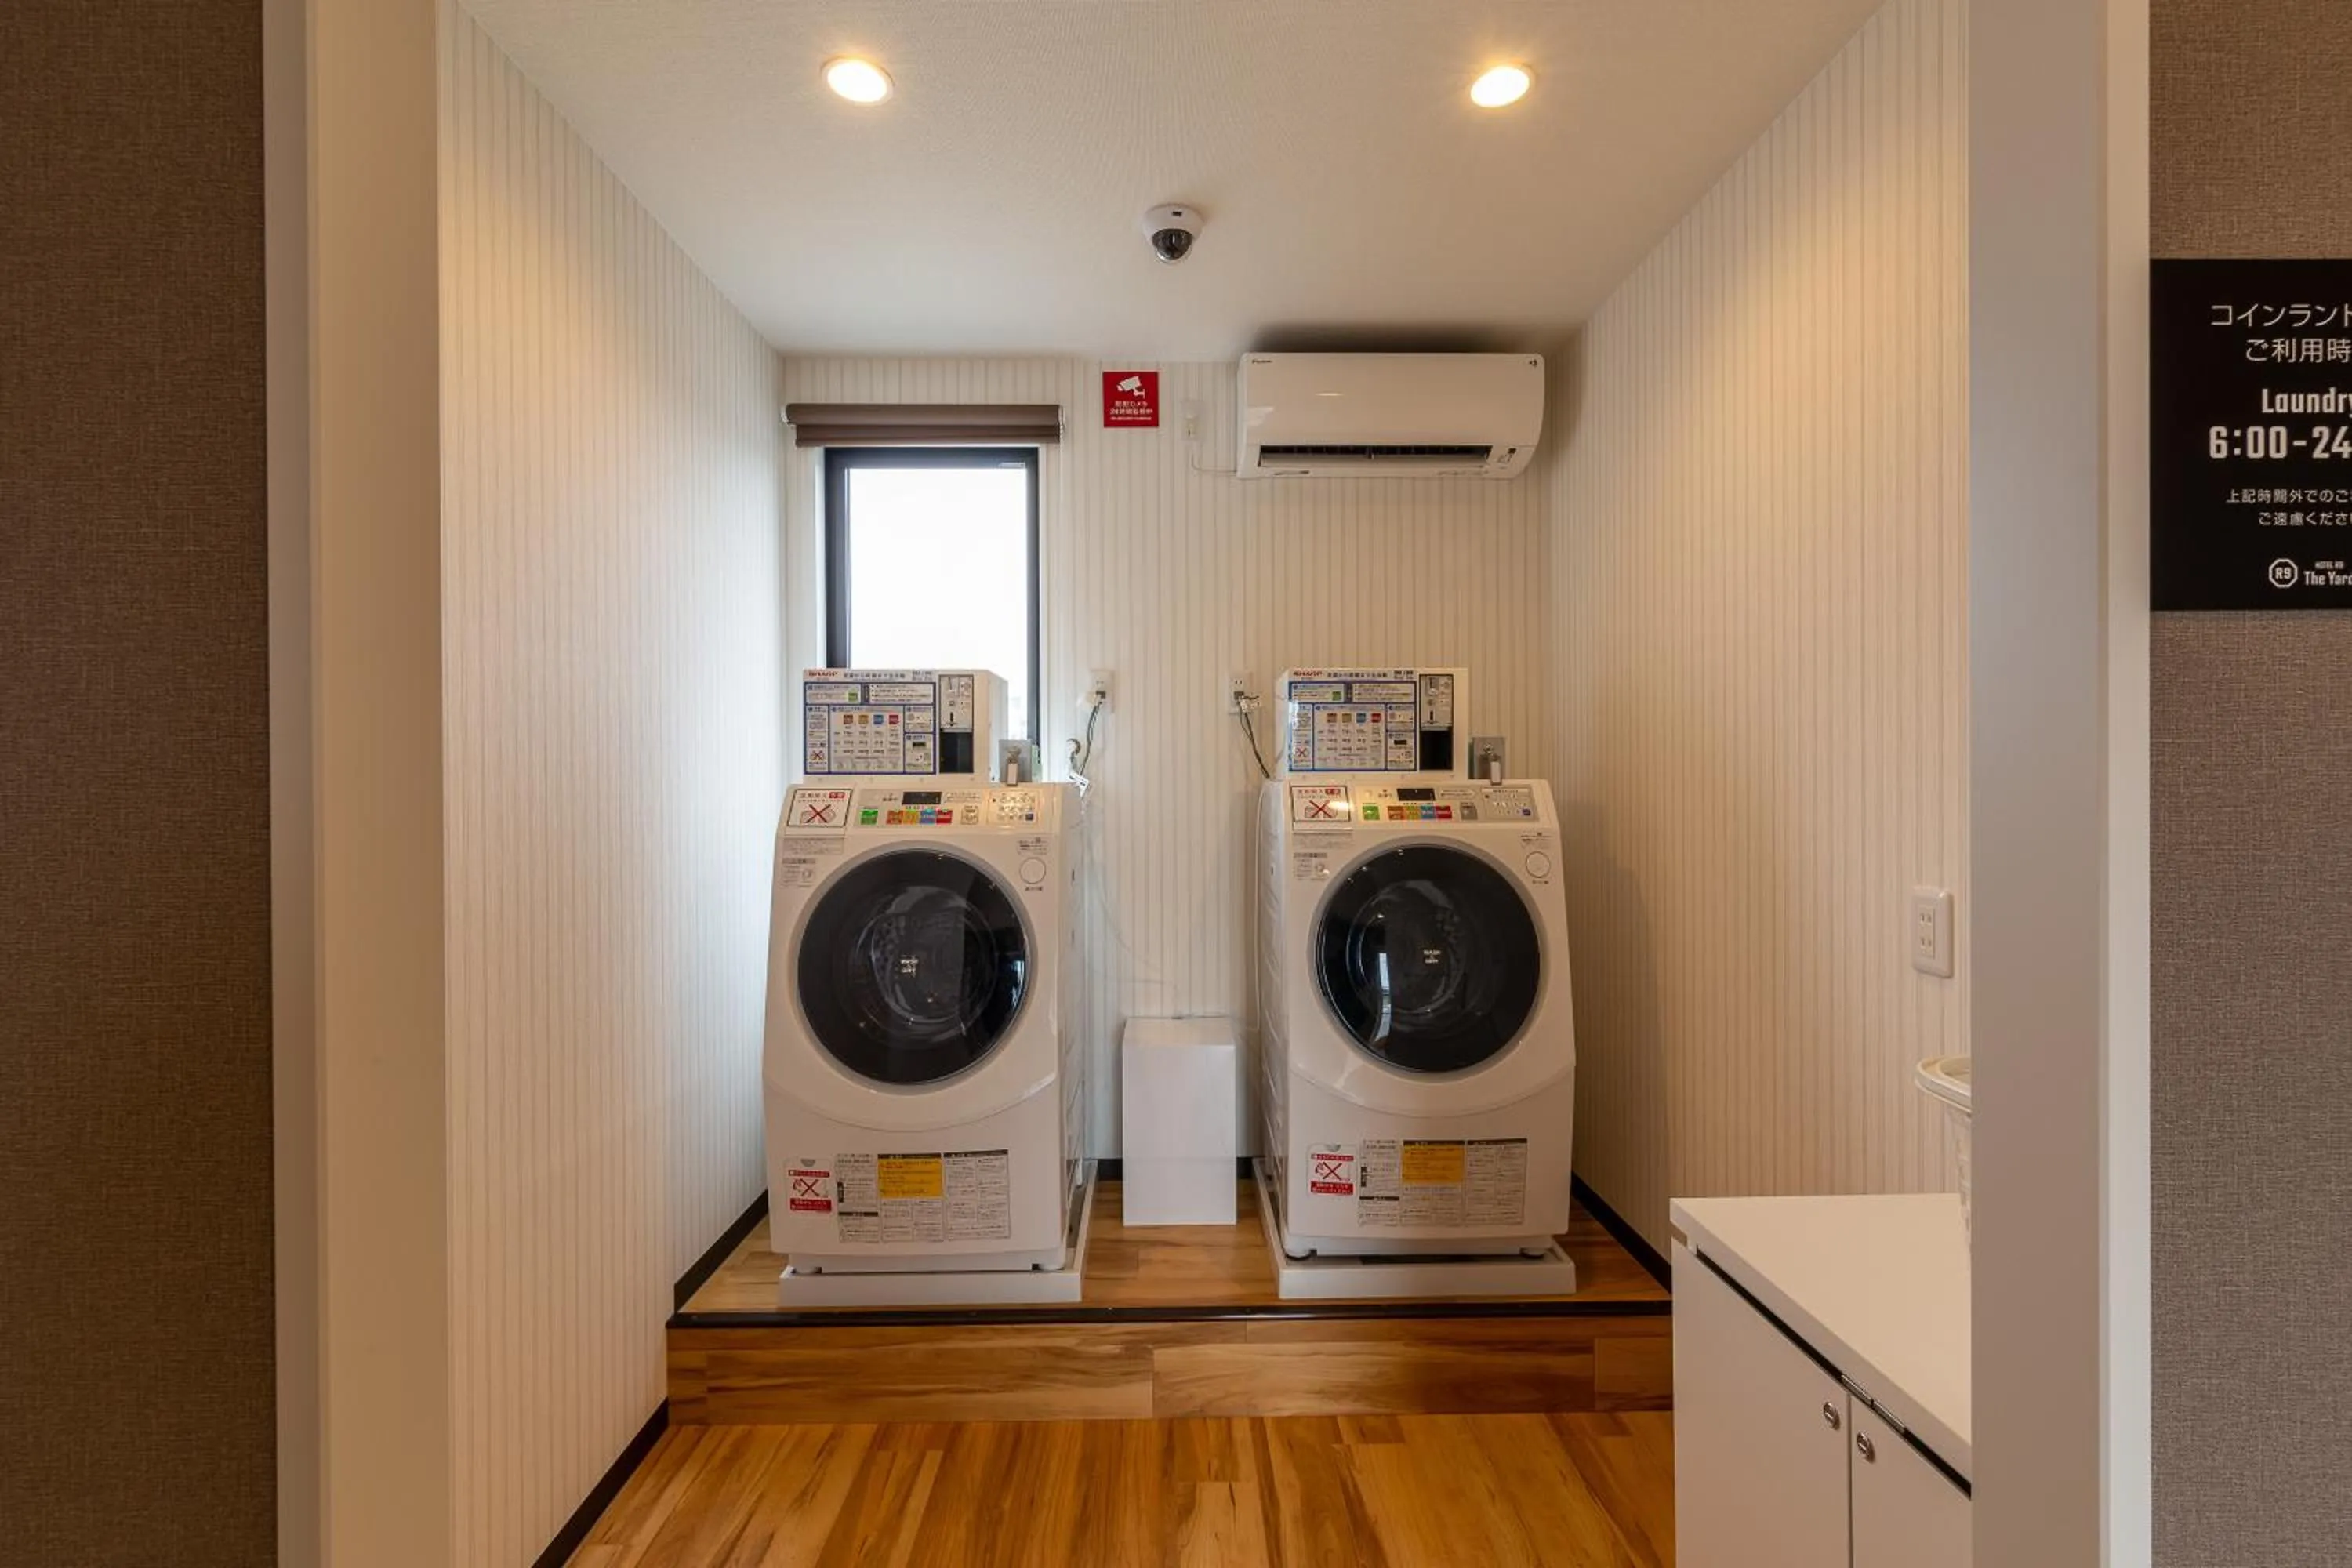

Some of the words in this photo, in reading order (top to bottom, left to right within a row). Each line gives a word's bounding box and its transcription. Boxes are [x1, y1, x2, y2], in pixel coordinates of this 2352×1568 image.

[2226, 488, 2352, 504] 上記時間外でのご
[2303, 571, 2326, 586] The
